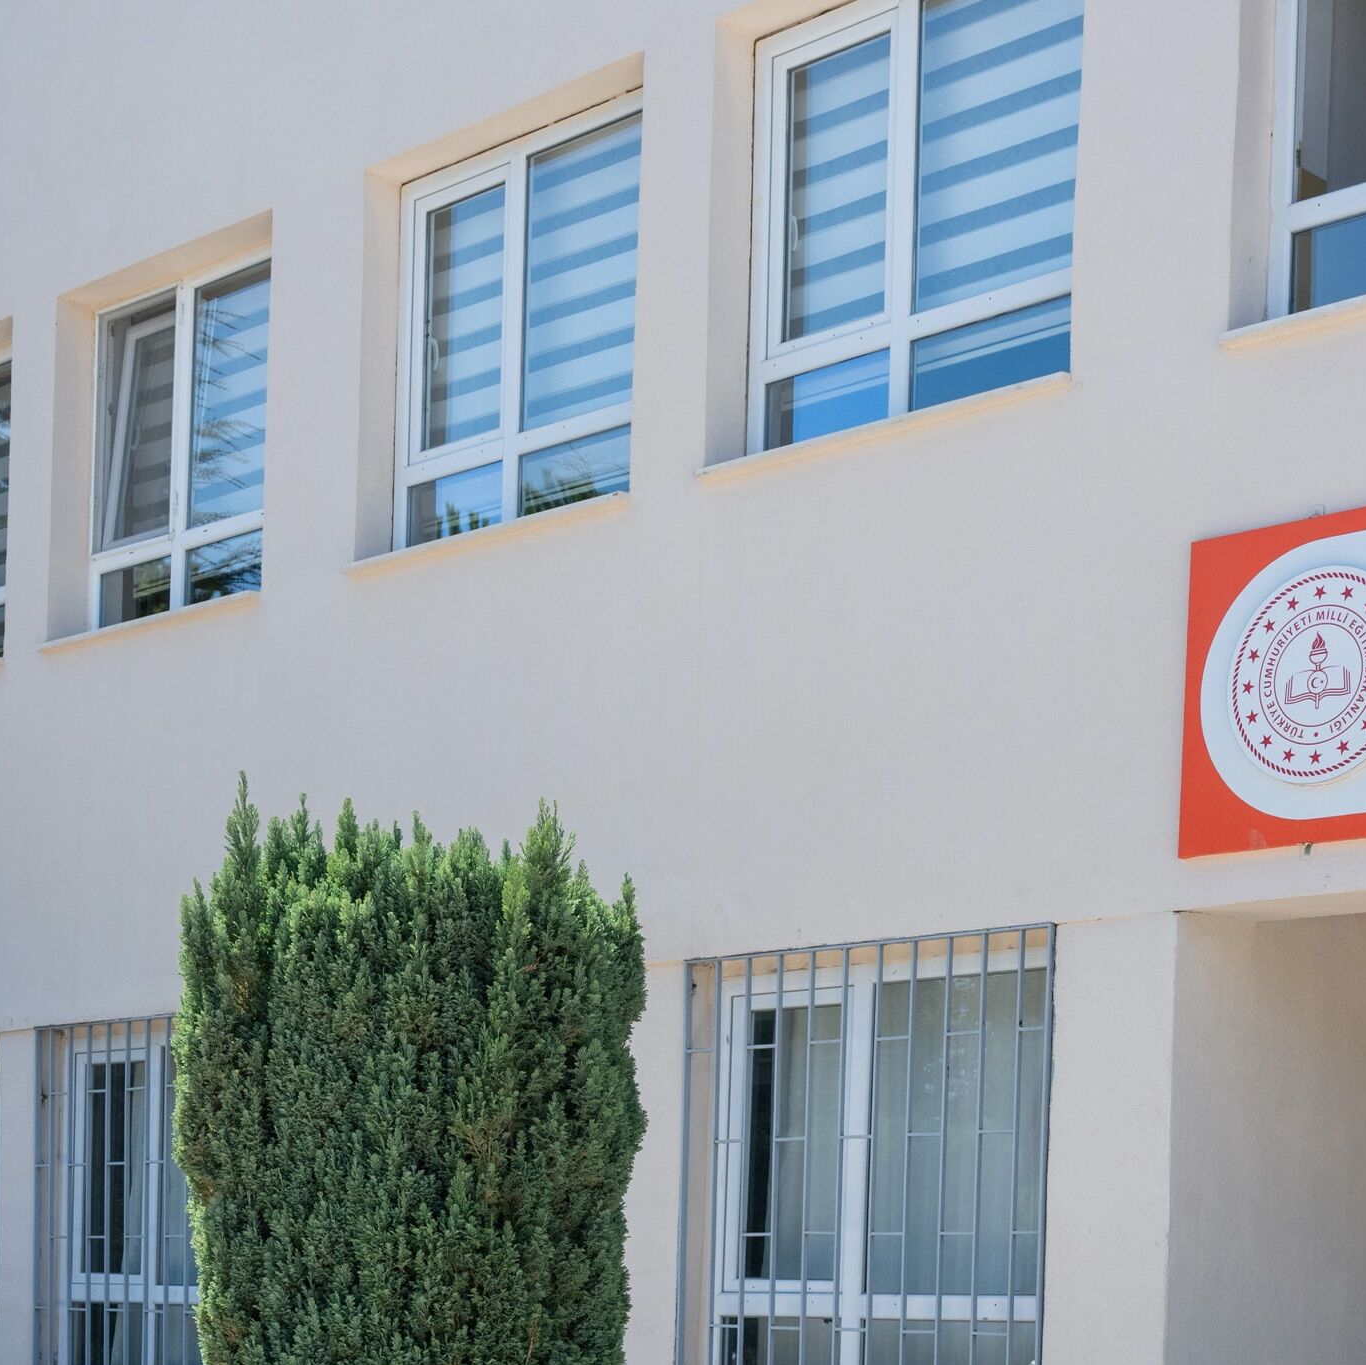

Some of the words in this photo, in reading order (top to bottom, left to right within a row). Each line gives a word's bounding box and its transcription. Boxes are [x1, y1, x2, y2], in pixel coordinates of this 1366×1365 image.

[1316, 608, 1349, 623] MİLLİ
[1264, 613, 1312, 697] CUMHURİYETİ
[1267, 701, 1304, 738] TÜRKİYE
